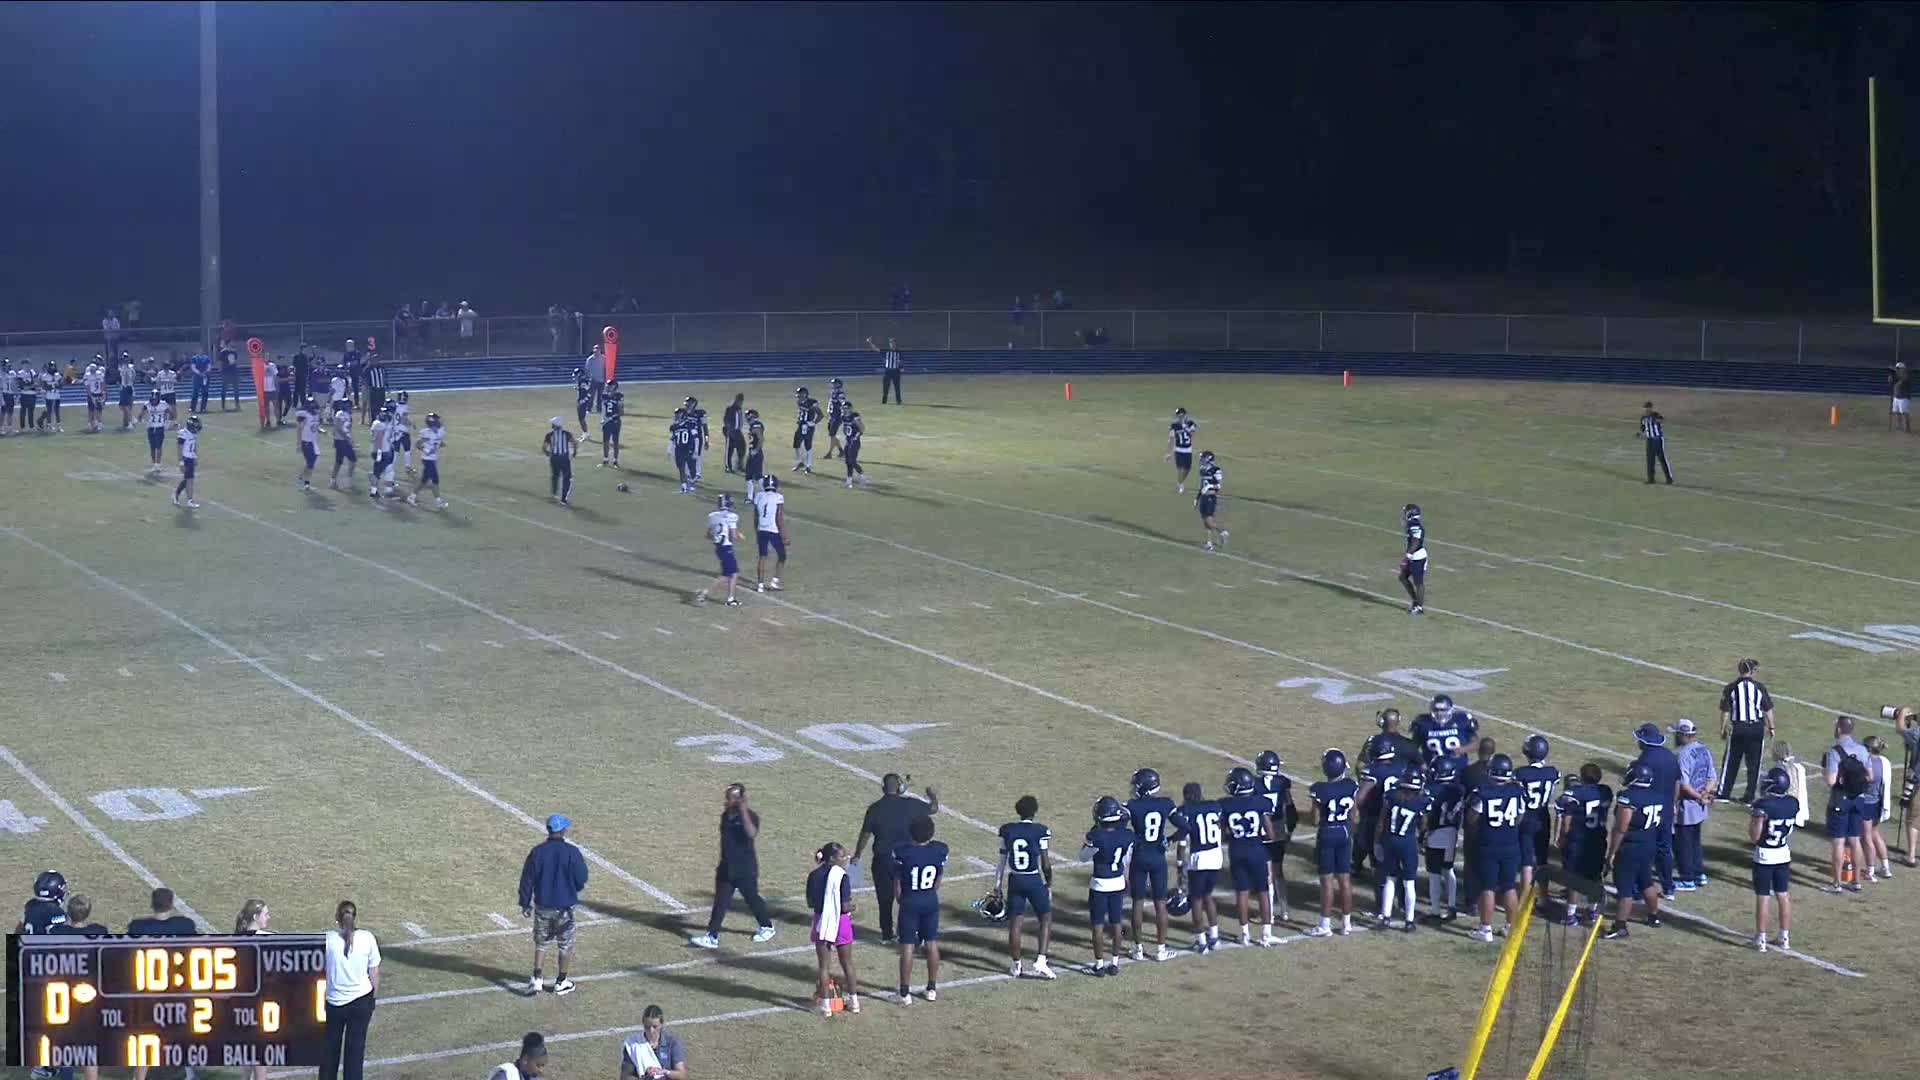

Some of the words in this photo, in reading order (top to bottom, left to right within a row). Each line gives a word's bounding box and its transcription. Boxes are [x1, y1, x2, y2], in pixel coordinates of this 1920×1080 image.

[675, 431, 689, 445] 70
[762, 502, 769, 518] 1
[1276, 668, 1489, 705] 20
[674, 723, 907, 764] 30
[1528, 780, 1552, 809] 51
[1145, 811, 1162, 842] 8
[1389, 805, 1416, 835] 17
[1487, 798, 1518, 827] 54
[1585, 800, 1600, 828] 5
[1642, 804, 1663, 830] 75
[1195, 812, 1221, 845] 16
[1767, 818, 1795, 846] 57
[1012, 838, 1030, 870] 6
[1111, 847, 1123, 872] 1
[910, 865, 937, 890] 18
